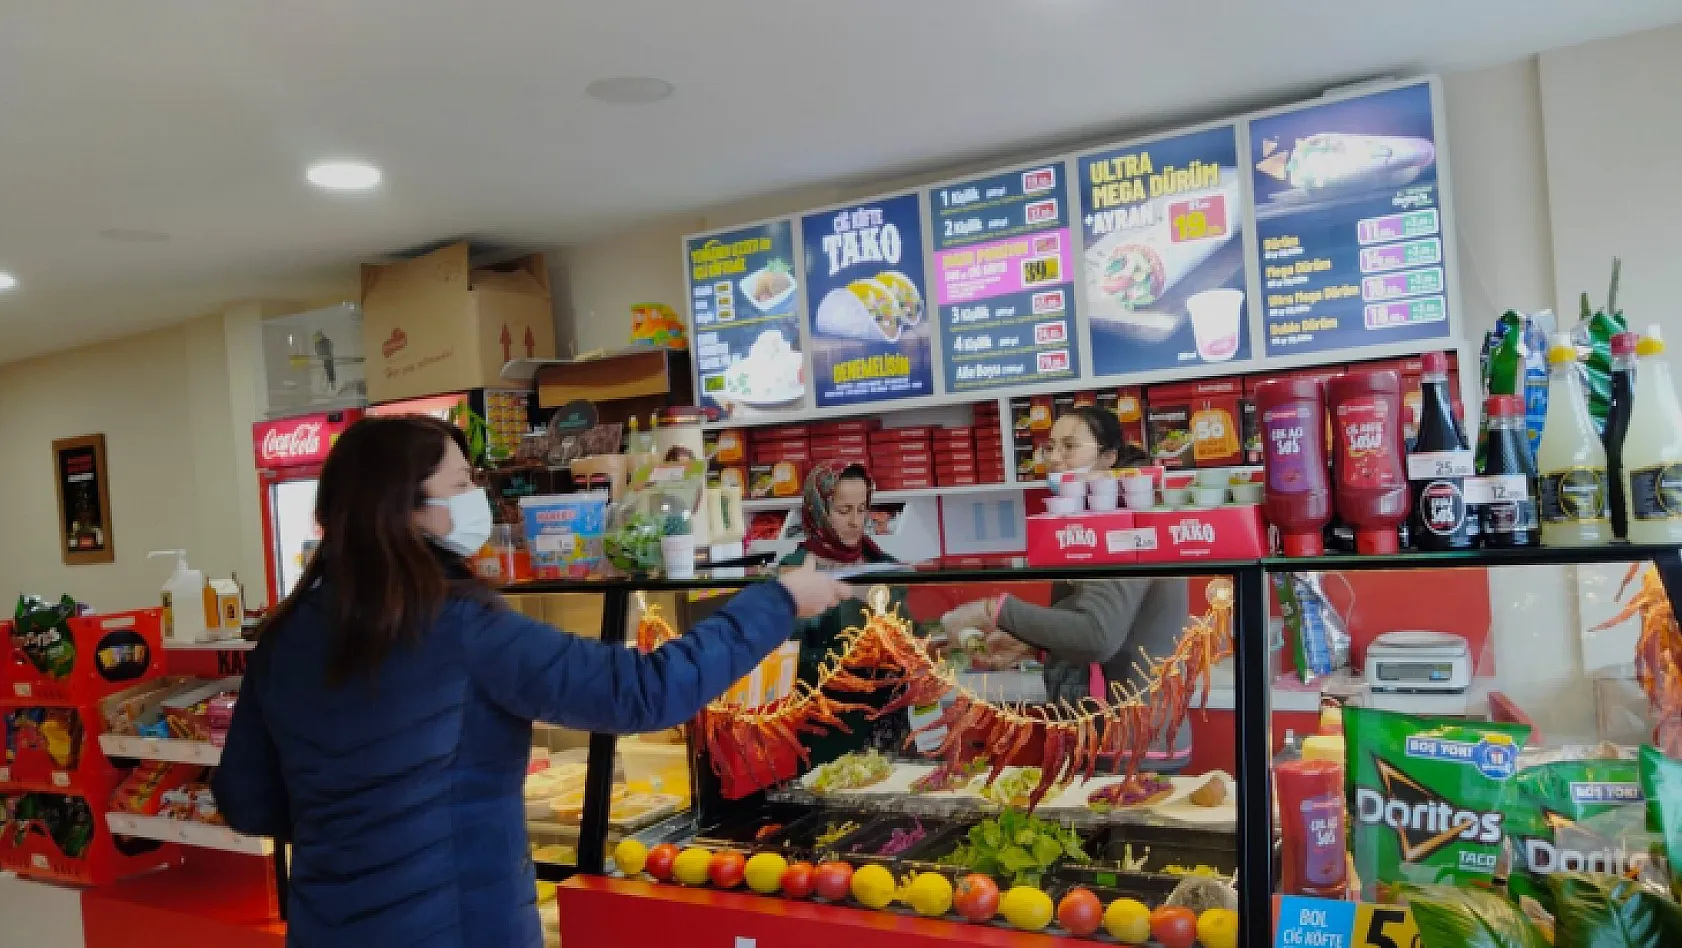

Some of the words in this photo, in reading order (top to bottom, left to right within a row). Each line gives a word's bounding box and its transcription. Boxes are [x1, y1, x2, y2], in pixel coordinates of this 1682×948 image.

[1090, 152, 1152, 182] ULTRA
[1092, 178, 1146, 208] MEGA
[1149, 159, 1219, 197] DÜRÜM
[944, 219, 953, 236] 2
[822, 223, 901, 277] TAKO
[1056, 528, 1098, 549] TAKO
[1169, 524, 1216, 546] TAKO
[1357, 787, 1503, 844] Doritos
[1459, 850, 1497, 867] TACO
[1299, 908, 1329, 928] BOL
